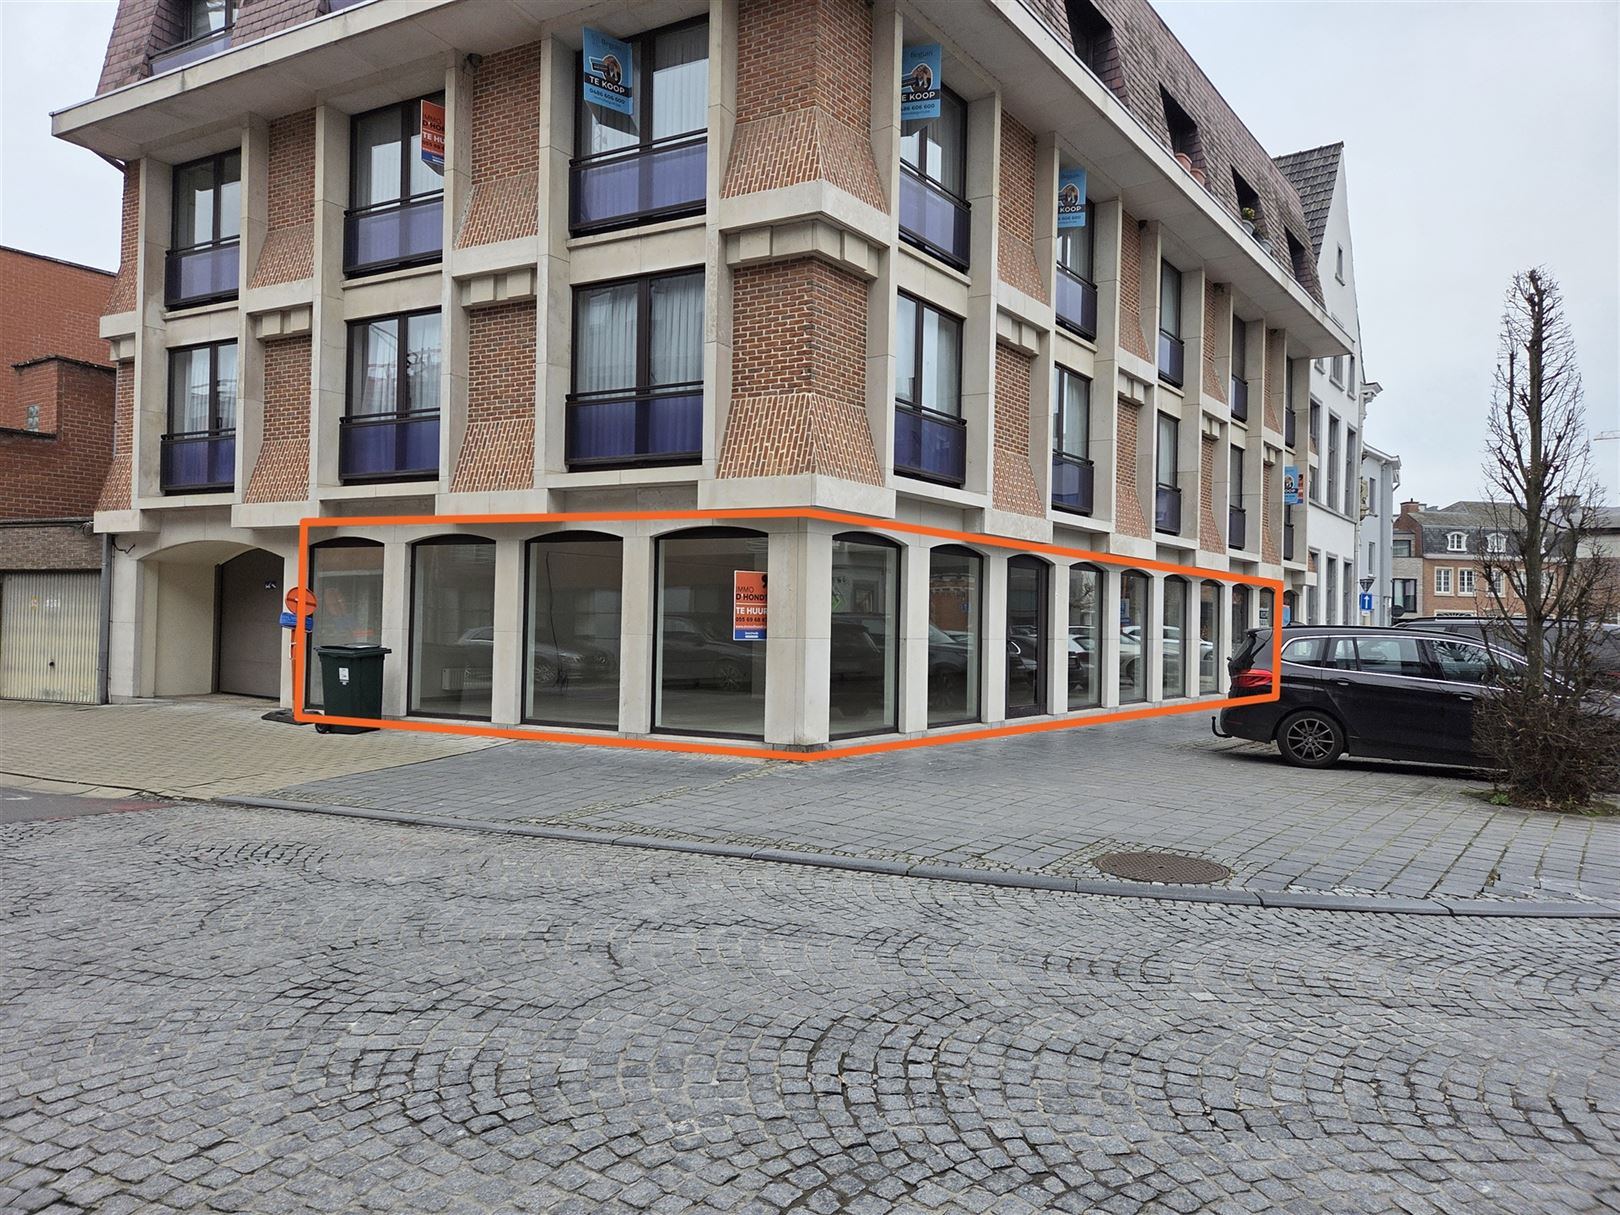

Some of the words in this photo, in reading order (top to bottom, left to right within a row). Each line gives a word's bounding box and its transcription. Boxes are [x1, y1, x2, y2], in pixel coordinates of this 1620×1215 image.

[589, 75, 600, 86] TE
[601, 80, 625, 93] KOOP
[909, 91, 936, 100] KOOP
[423, 131, 432, 141] TE
[433, 135, 445, 145] HU
[1060, 205, 1082, 213] KOOP
[736, 586, 755, 594] IMMO
[736, 606, 745, 615] TE
